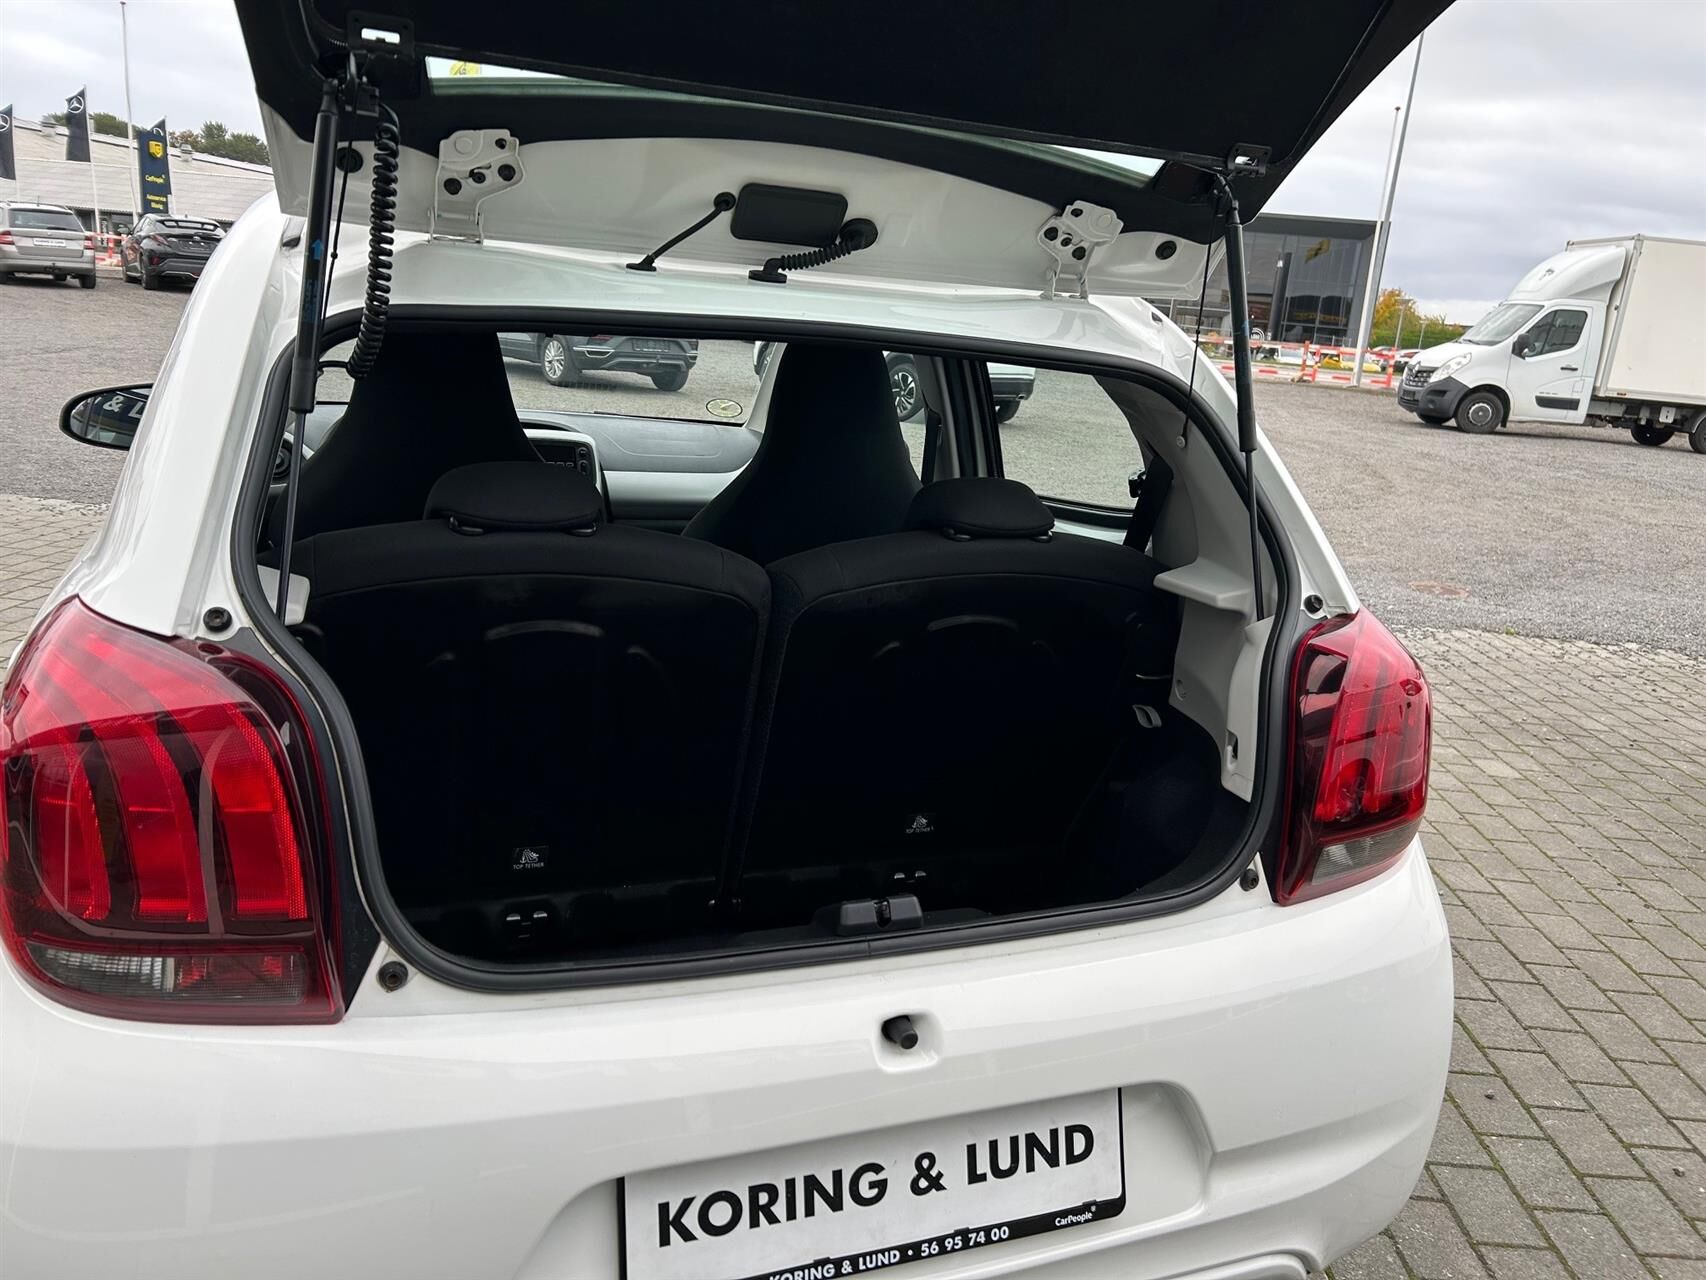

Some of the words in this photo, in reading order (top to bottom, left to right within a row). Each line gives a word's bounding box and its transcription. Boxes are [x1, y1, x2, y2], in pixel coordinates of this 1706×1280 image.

[658, 1163, 888, 1248] KORING
[910, 1152, 947, 1197] &
[967, 1123, 1095, 1186] LUND
[841, 1260, 853, 1274] &
[859, 1250, 901, 1270] LUND
[920, 1242, 939, 1257] 56
[944, 1235, 964, 1251] 95
[968, 1231, 987, 1246] 74
[990, 1227, 1009, 1241] 00
